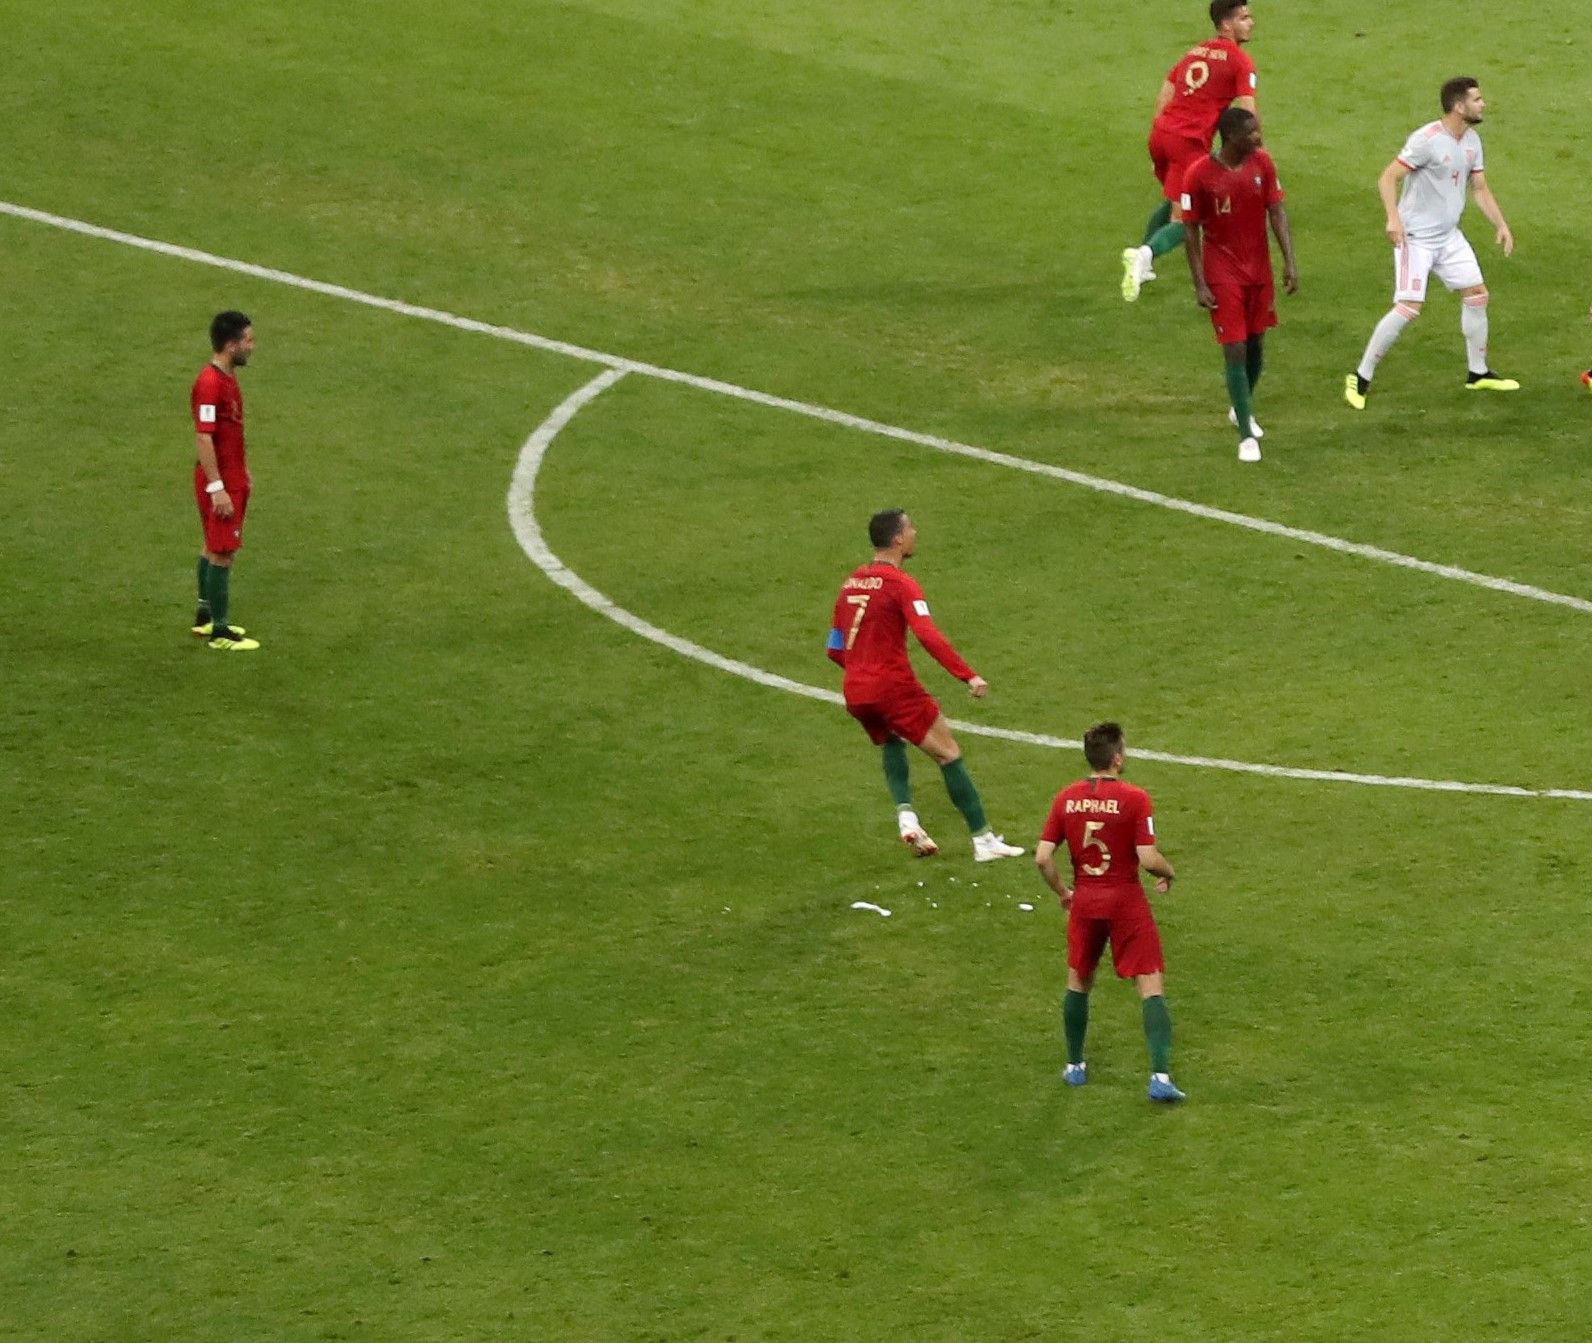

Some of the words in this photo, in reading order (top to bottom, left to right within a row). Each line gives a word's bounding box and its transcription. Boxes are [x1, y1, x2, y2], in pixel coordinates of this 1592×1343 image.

[1182, 60, 1210, 97] 9
[1215, 193, 1232, 217] 14
[846, 594, 870, 651] 7
[1066, 798, 1119, 815] RAPHAEL
[1082, 820, 1112, 877] 5
